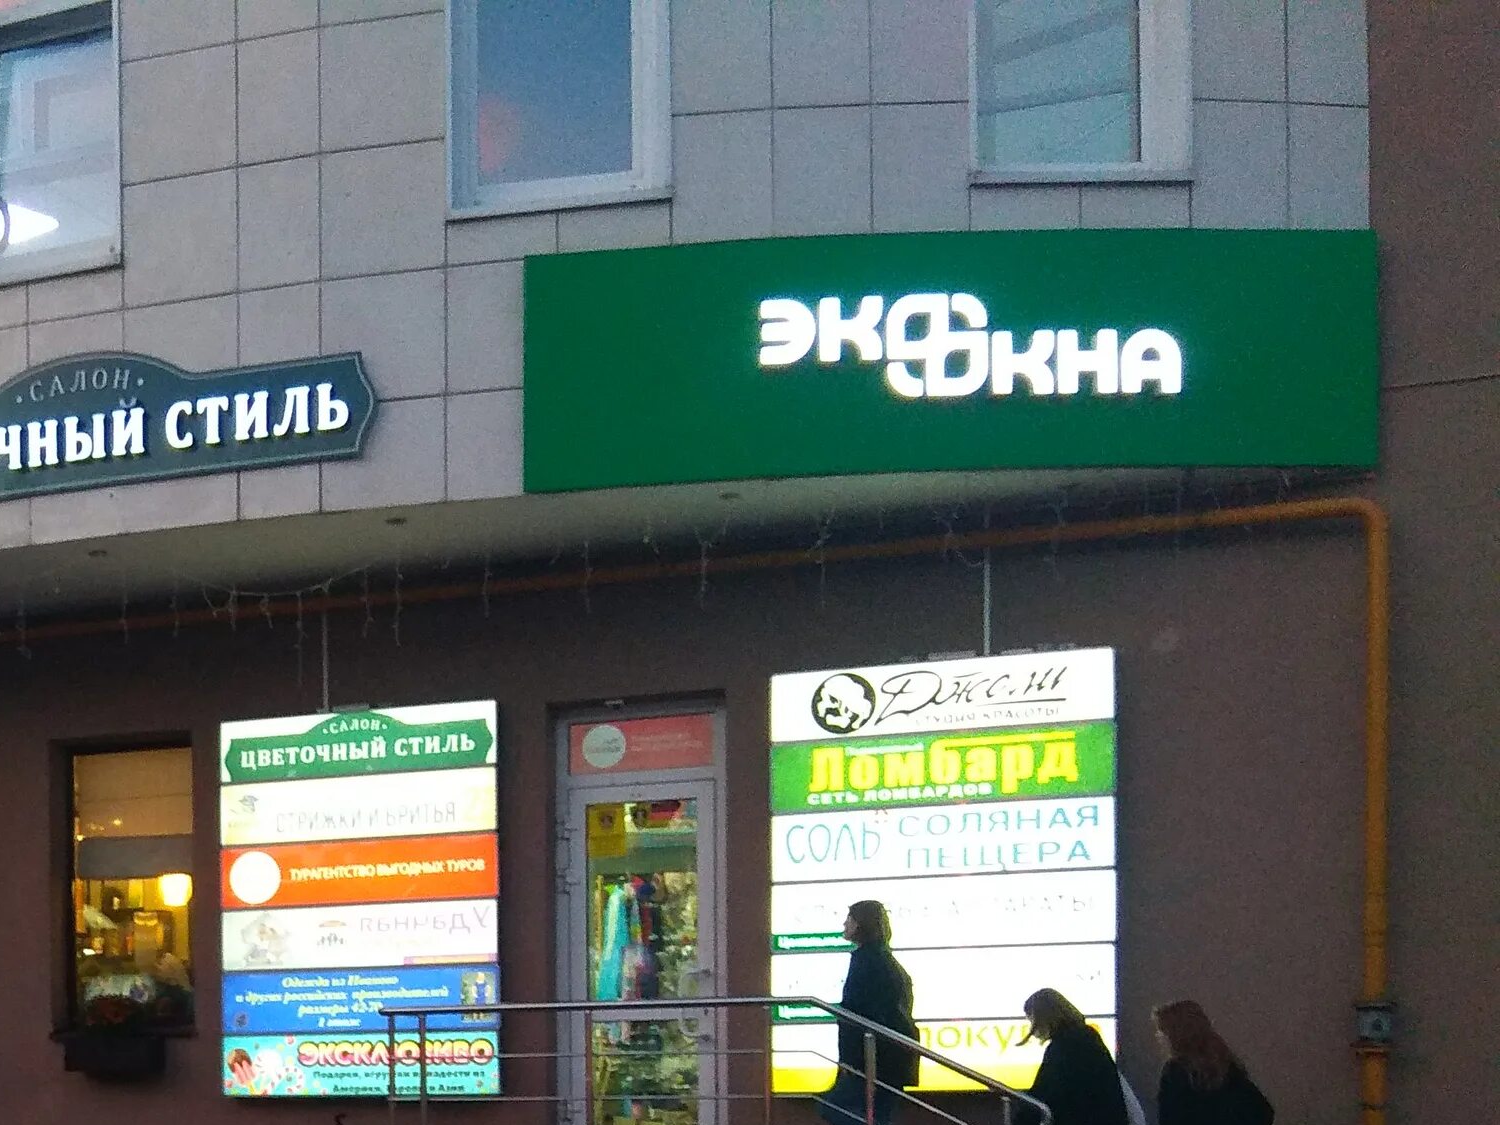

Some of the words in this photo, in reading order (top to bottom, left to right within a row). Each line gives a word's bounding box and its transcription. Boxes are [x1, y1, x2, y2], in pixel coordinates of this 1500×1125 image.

[29, 366, 131, 403] САЛОН
[165, 382, 350, 451] СТИЛЬ
[329, 718, 381, 735] САЛОН
[240, 736, 388, 771] ЦВЕТОЧНЫЙ
[394, 732, 476, 756] СТИЛЬ
[809, 731, 1078, 794] Ломбард
[786, 821, 881, 864] СОЛЬ
[898, 805, 1100, 837] СОЛЯНАЯ
[907, 840, 1091, 873] ПЕЩЕРА
